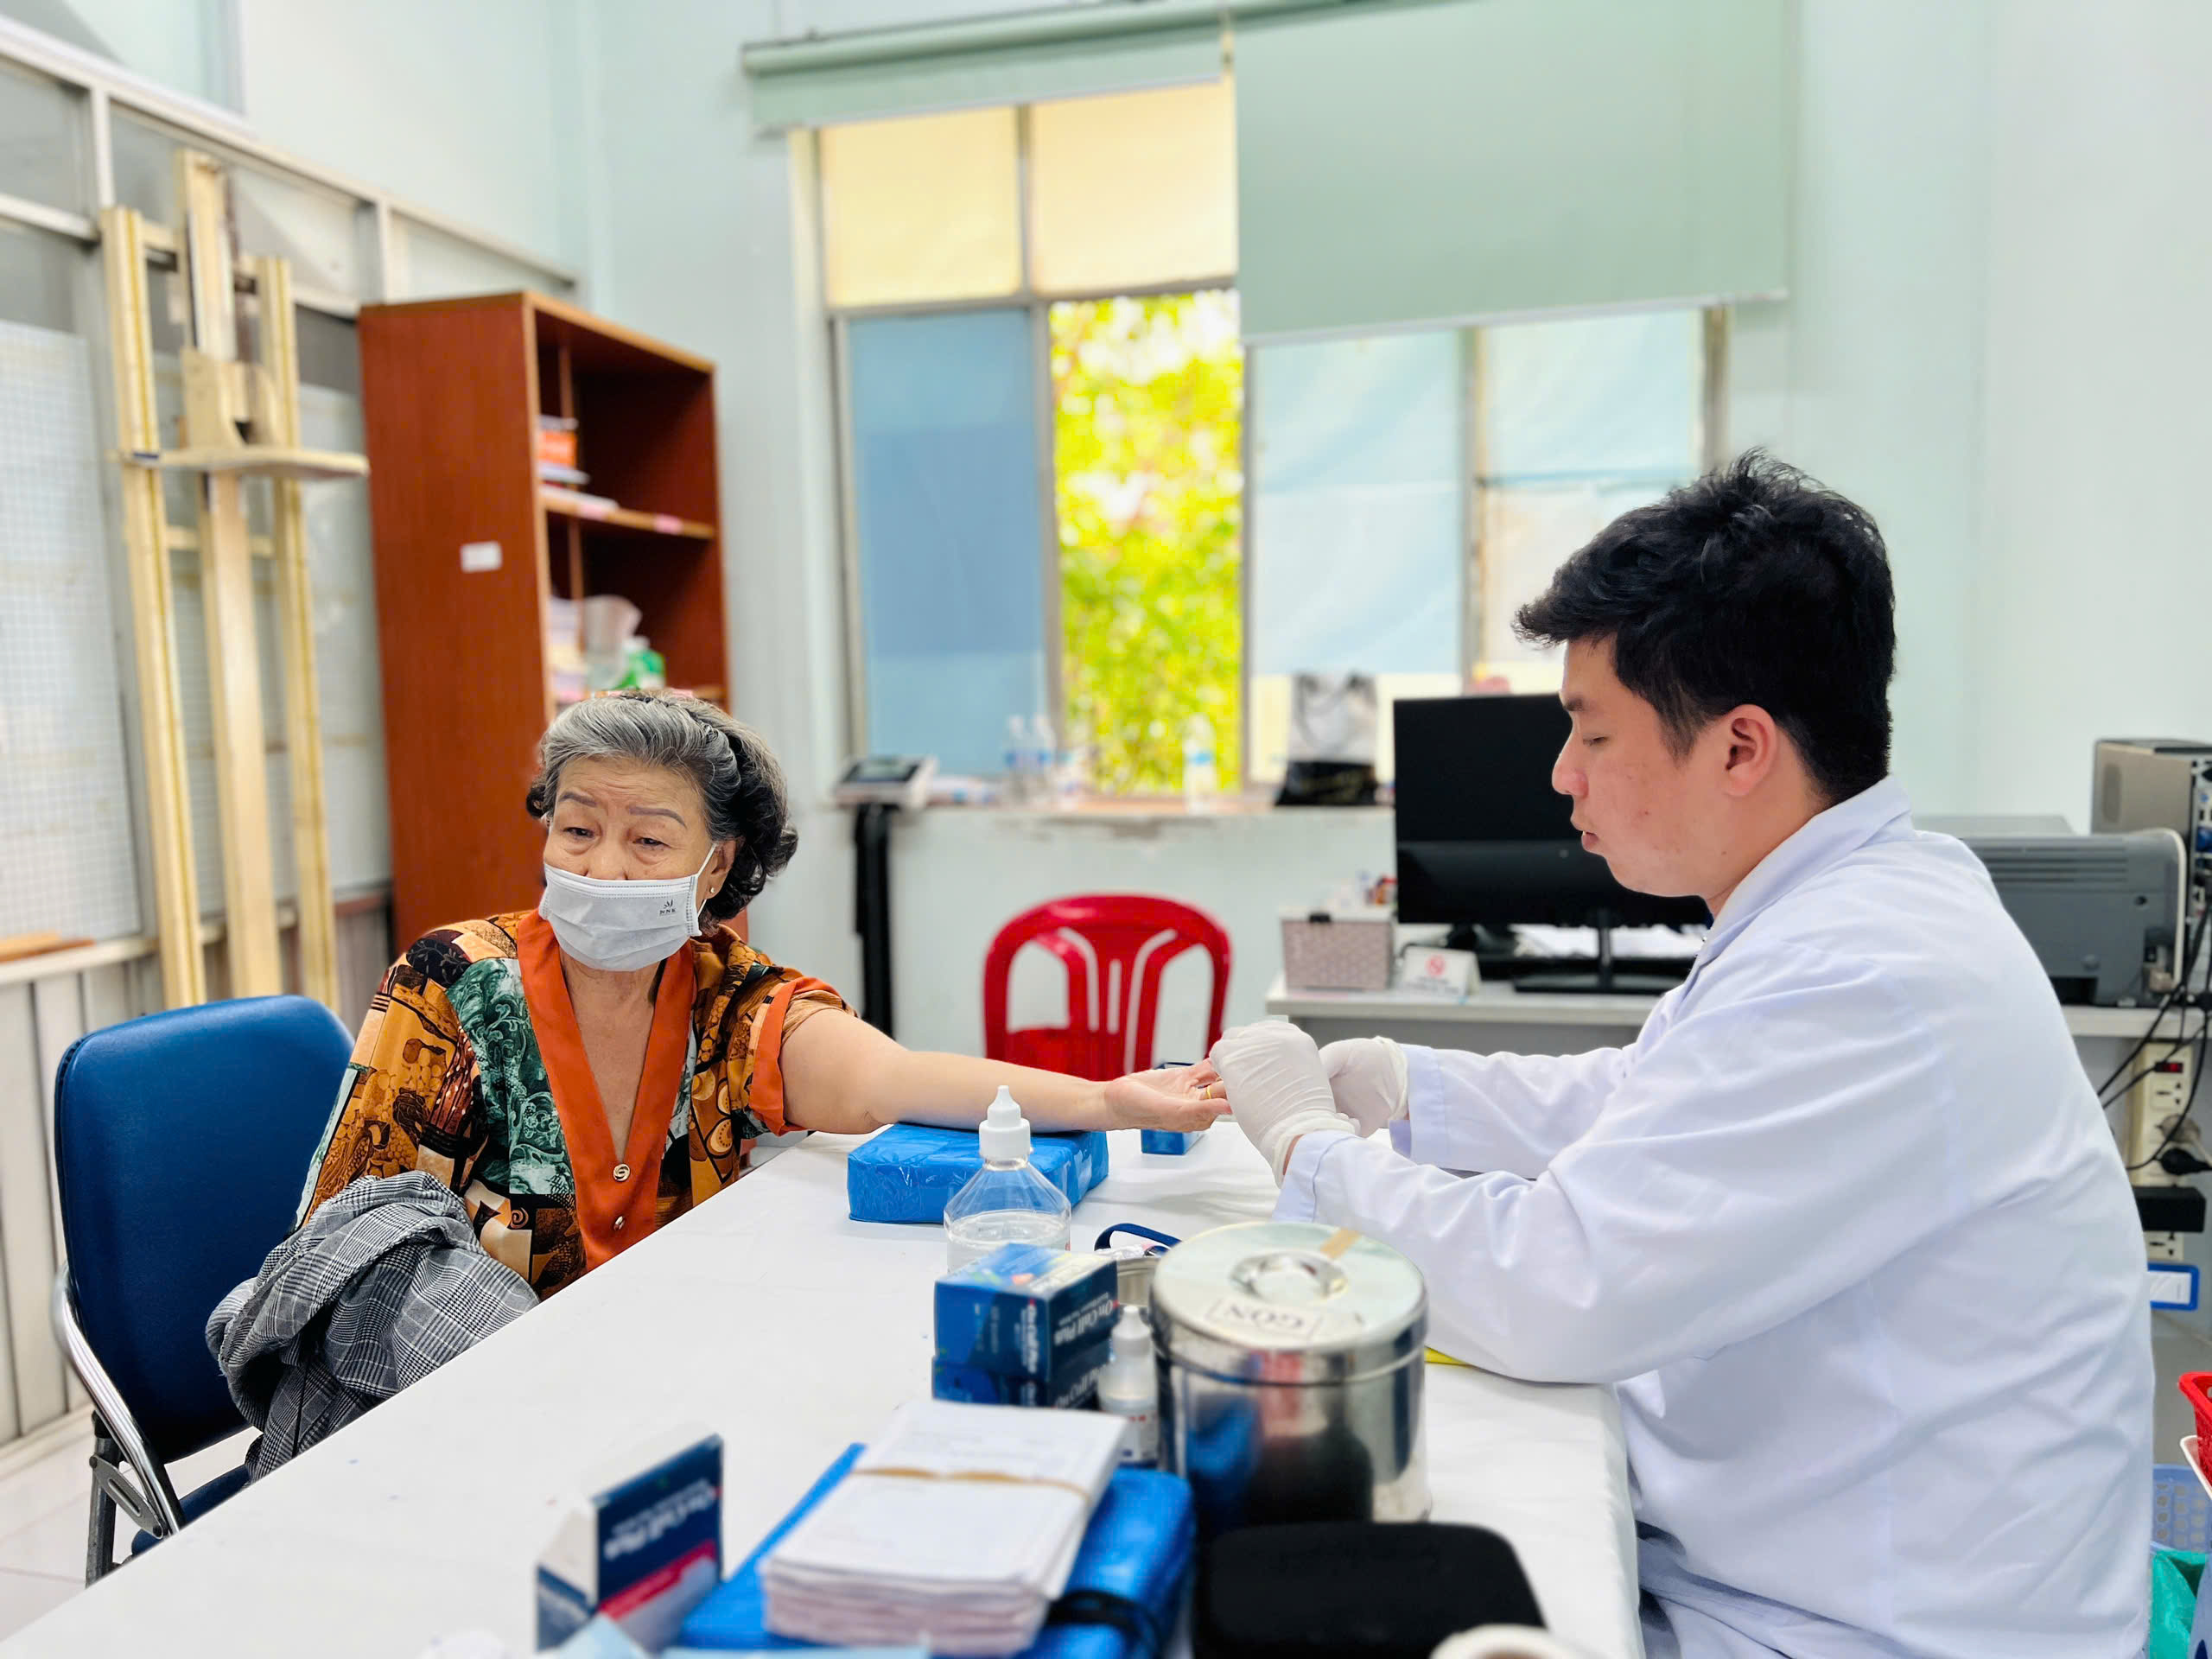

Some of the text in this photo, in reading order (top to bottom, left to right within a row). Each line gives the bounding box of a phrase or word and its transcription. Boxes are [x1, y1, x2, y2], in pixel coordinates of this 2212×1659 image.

[1098, 1299, 1113, 1316] On
[1053, 1321, 1077, 1345] Plus
[1077, 1309, 1098, 1336] Call
